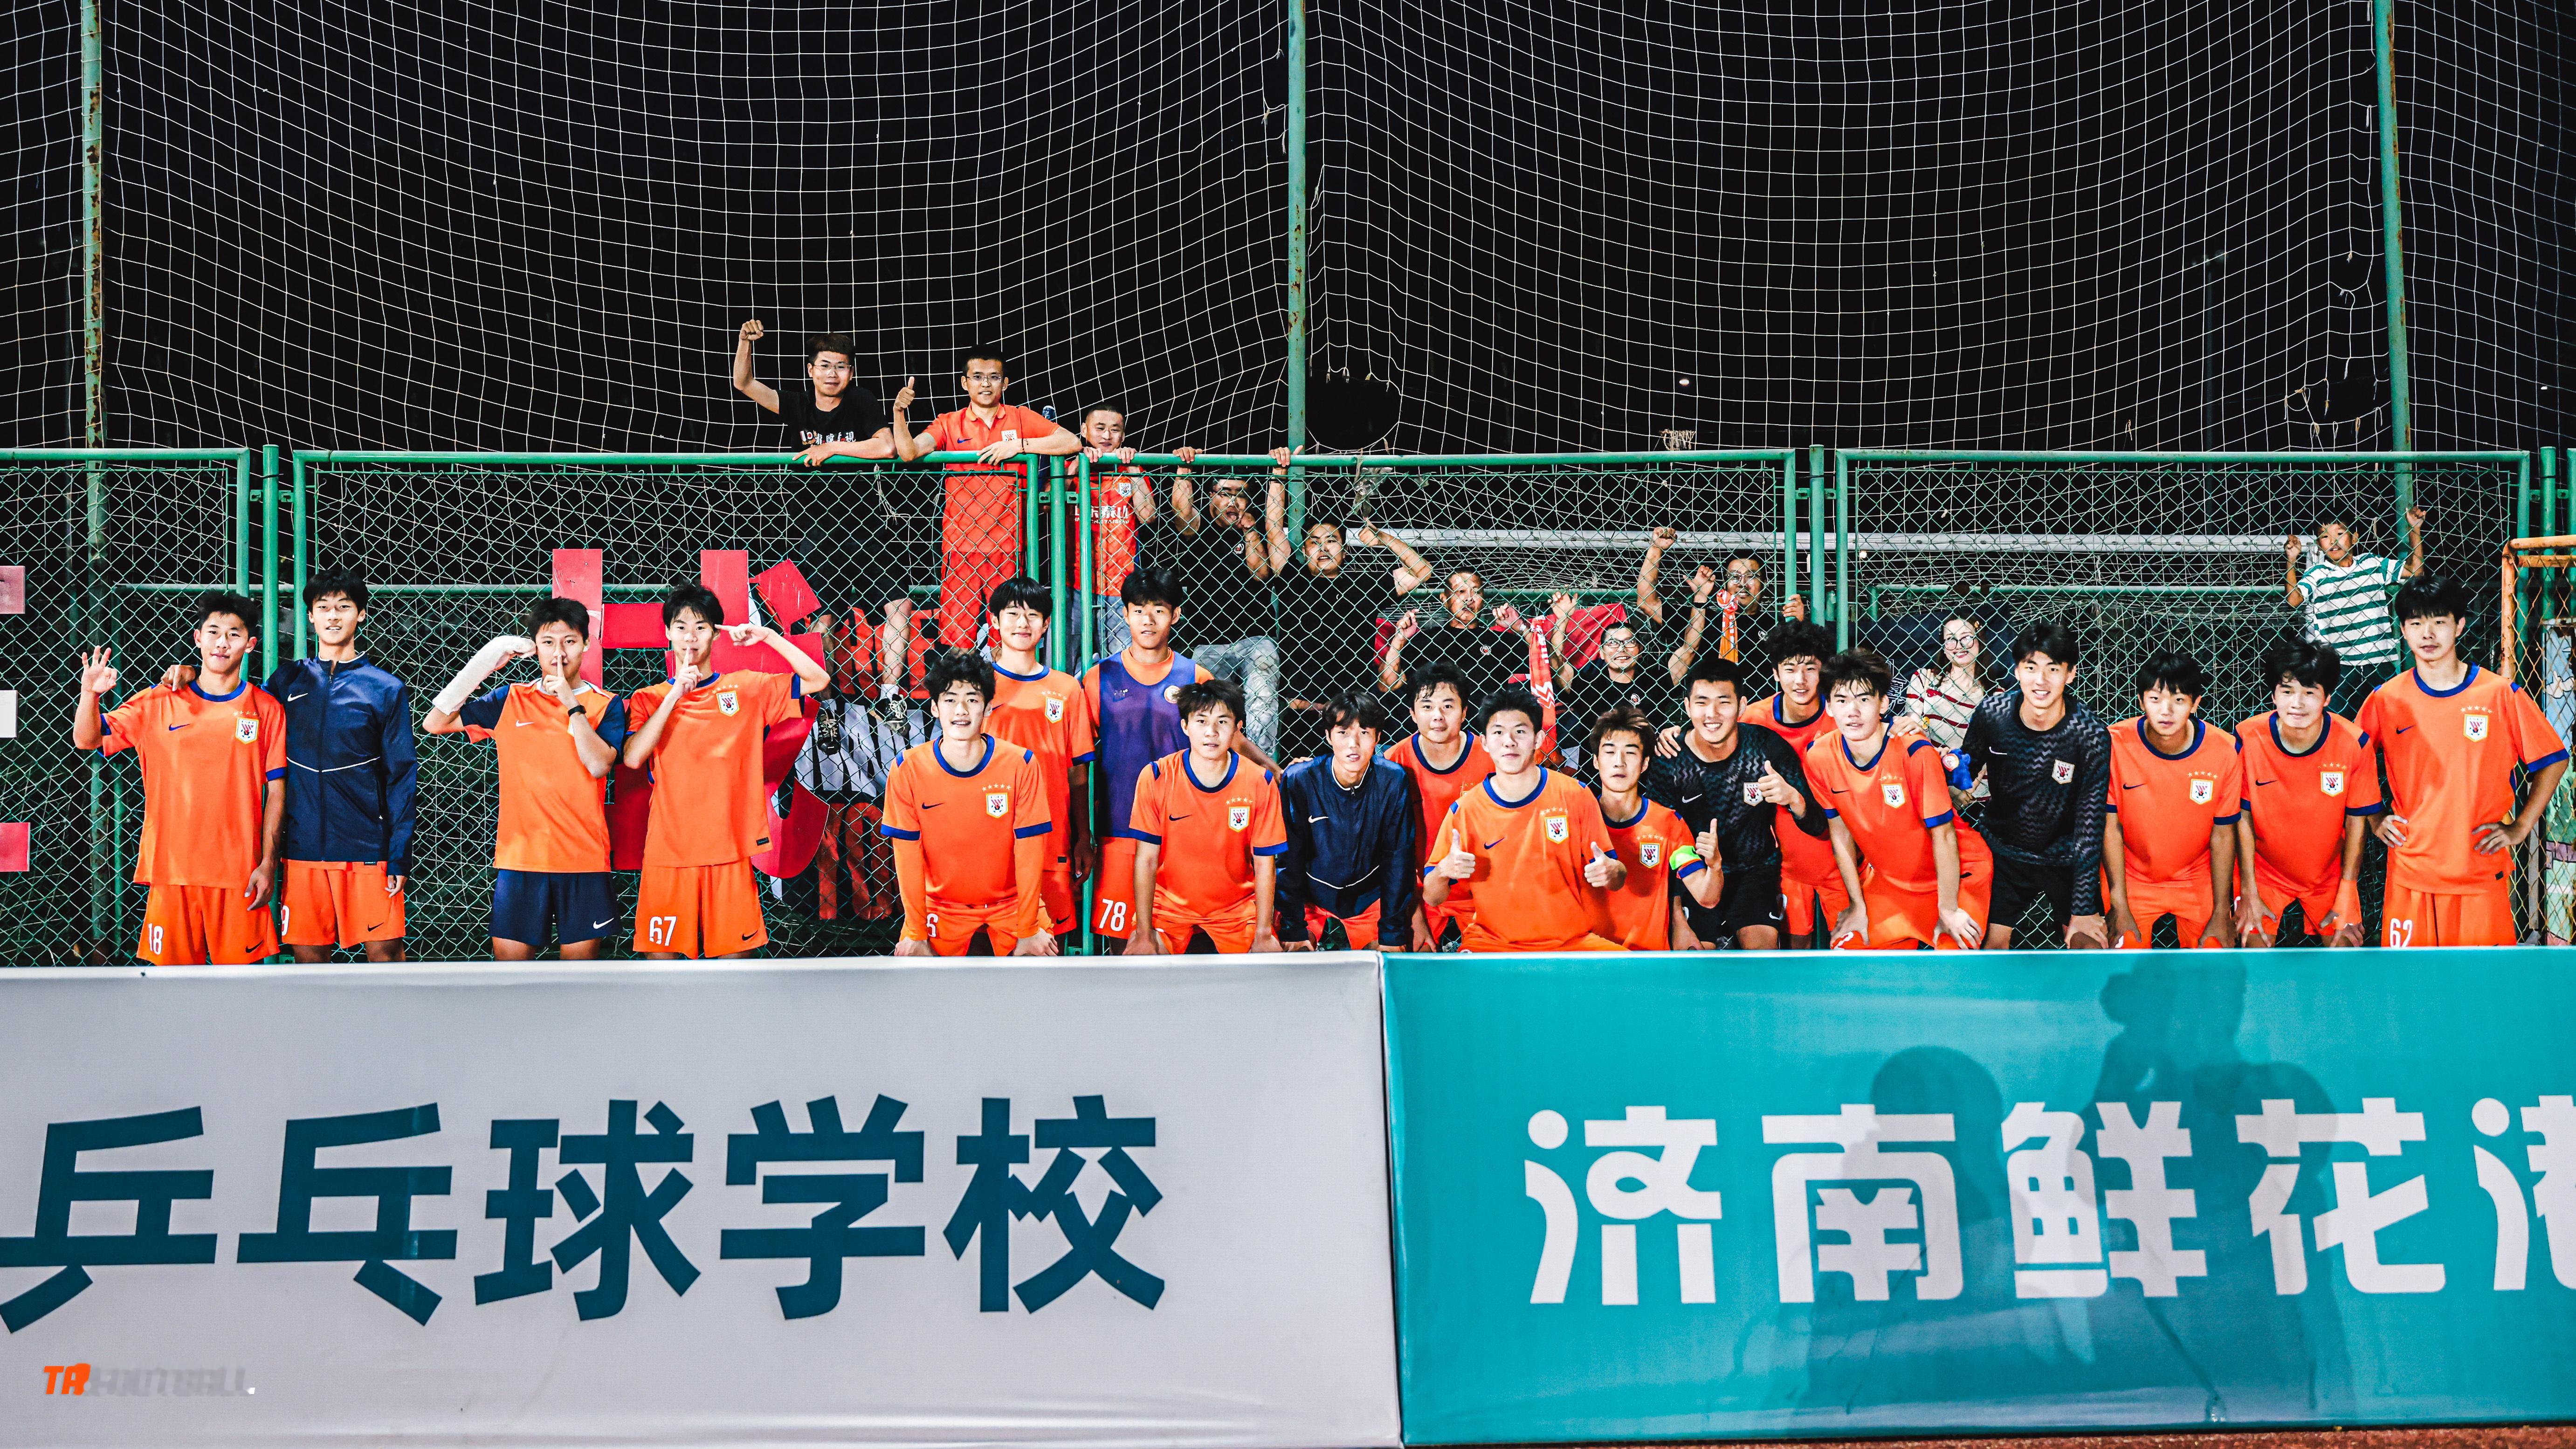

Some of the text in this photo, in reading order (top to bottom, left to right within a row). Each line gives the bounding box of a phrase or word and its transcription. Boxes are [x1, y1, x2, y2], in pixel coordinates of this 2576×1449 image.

[1098, 898, 1127, 932] 78
[148, 923, 163, 955] 18
[649, 916, 677, 947] 67
[2390, 918, 2413, 948] 62
[0, 1094, 1165, 1334] 乒乓球学校
